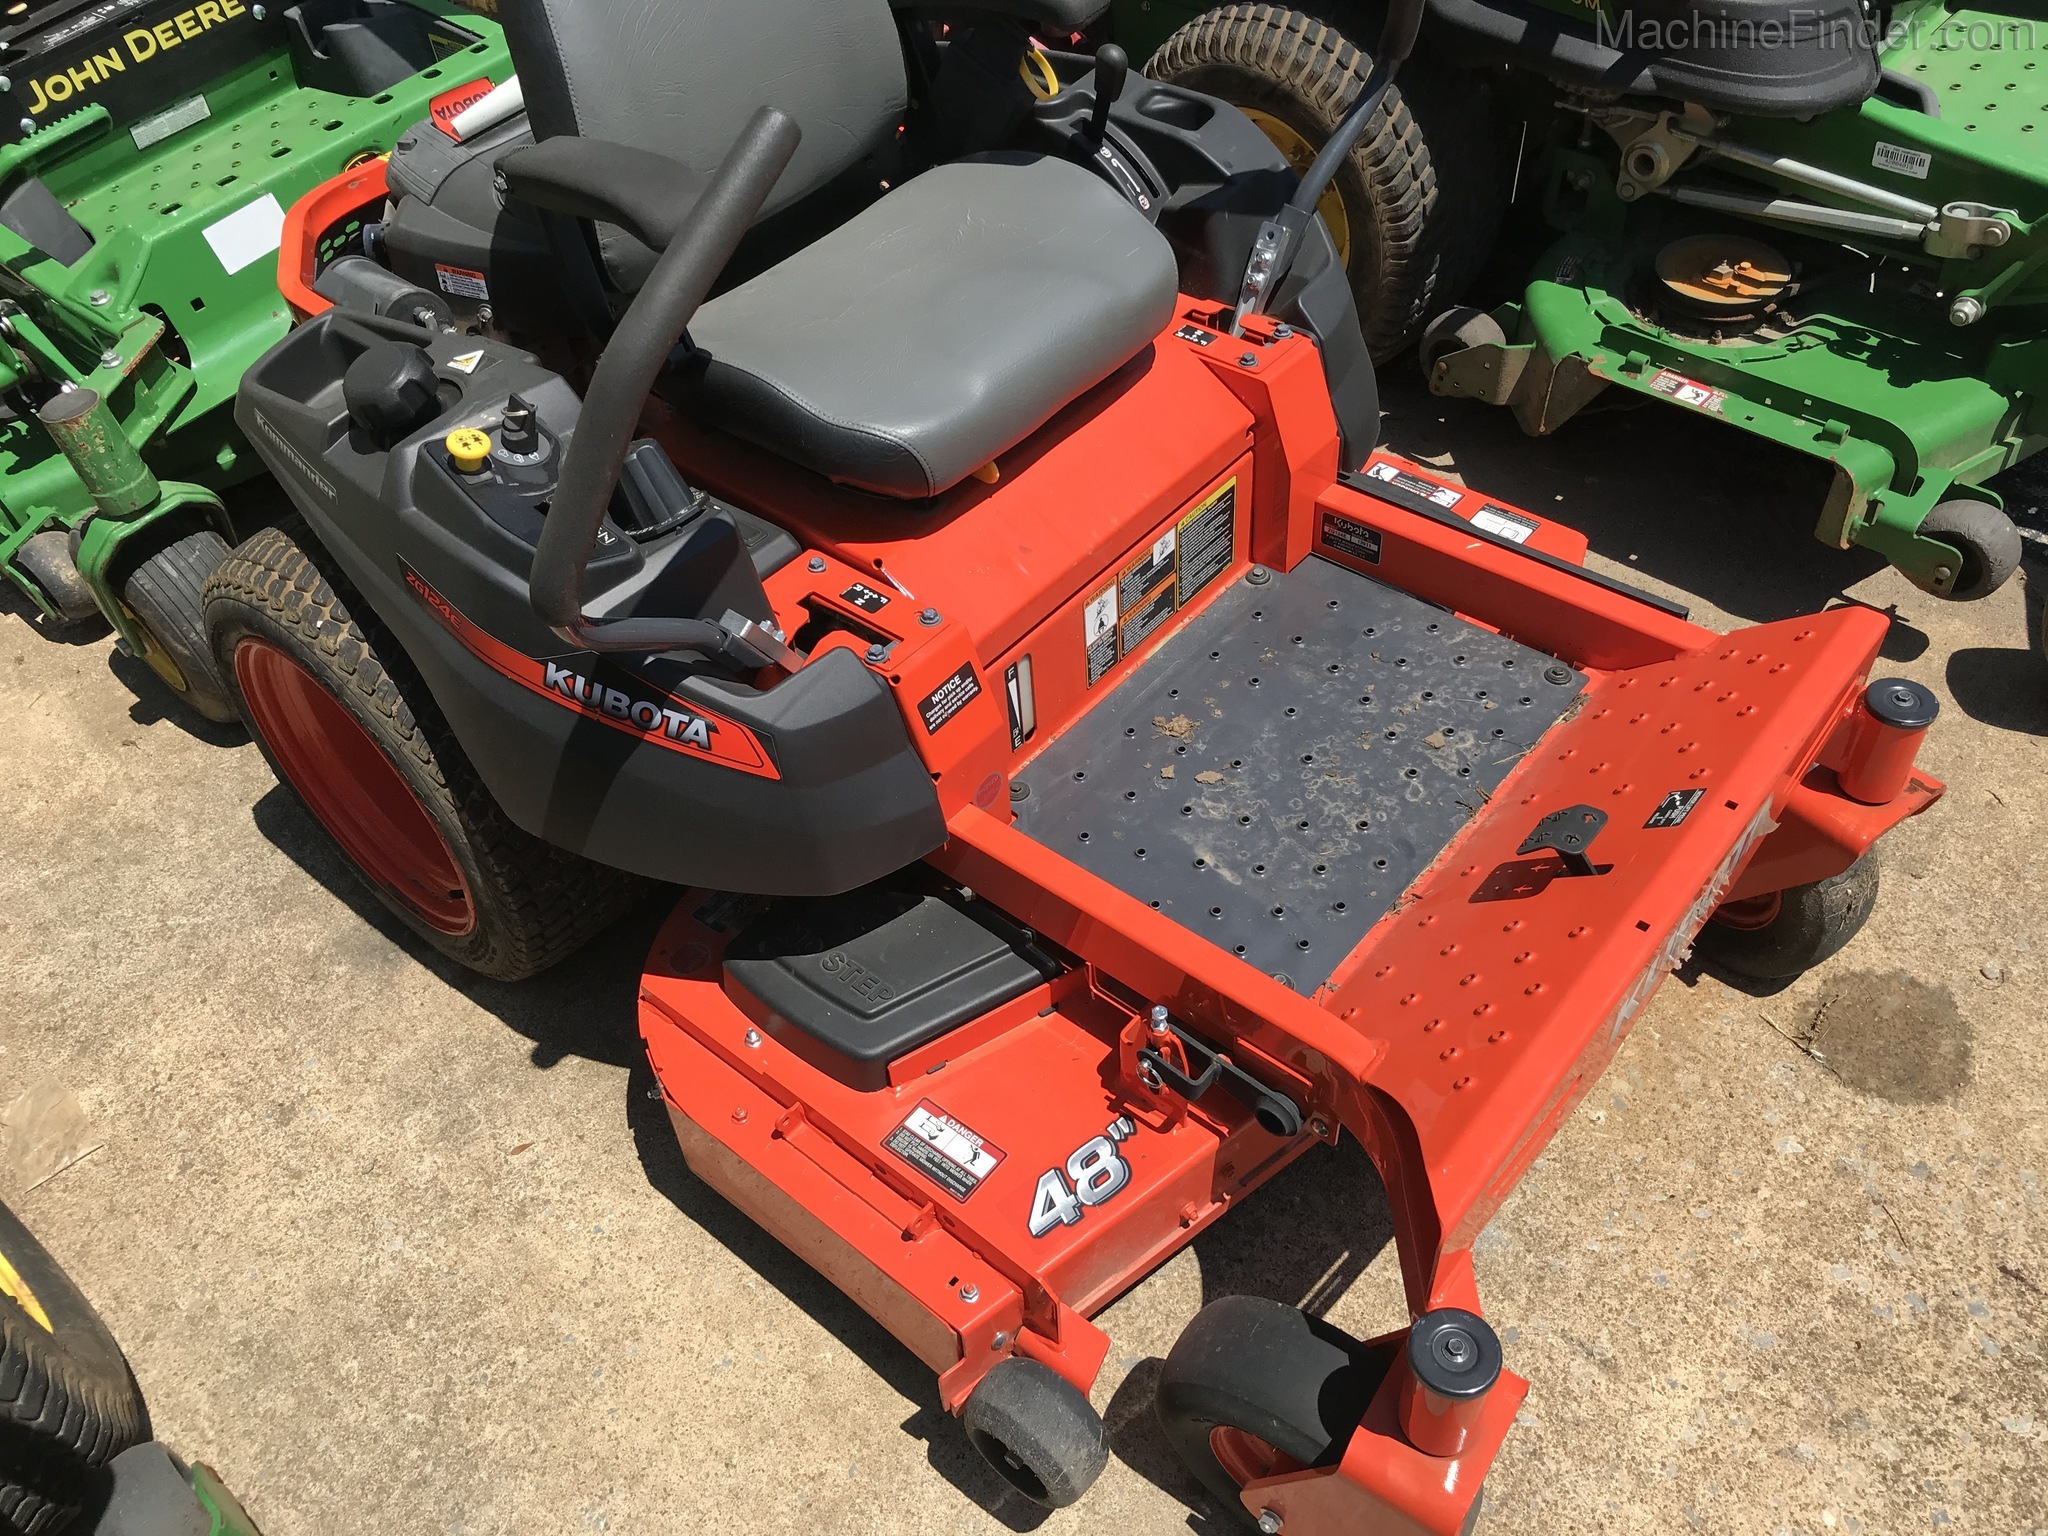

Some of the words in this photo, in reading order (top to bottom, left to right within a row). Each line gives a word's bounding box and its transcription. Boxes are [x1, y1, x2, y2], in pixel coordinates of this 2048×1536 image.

[28, 47, 127, 115] JOHN
[123, 0, 247, 64] DEERE
[254, 410, 336, 500] Kommander
[1185, 502, 1207, 523] CAUTION
[1334, 517, 1370, 538] Kubota
[405, 571, 461, 629] ZG124E
[930, 674, 961, 705] NOTICE
[1008, 666, 1016, 680] F
[545, 661, 713, 751] KUBOTA
[925, 702, 942, 719] Charges
[946, 690, 956, 701] pick
[955, 685, 961, 694] up
[928, 722, 936, 730] are
[934, 716, 942, 725] not
[956, 699, 962, 707] by
[929, 707, 944, 723] delivery
[943, 700, 952, 710] and
[951, 689, 965, 703] service
[1014, 735, 1023, 748] E
[821, 952, 895, 1003] STEP
[946, 1118, 984, 1147] DANGER
[1028, 1116, 1137, 1239] 48"
